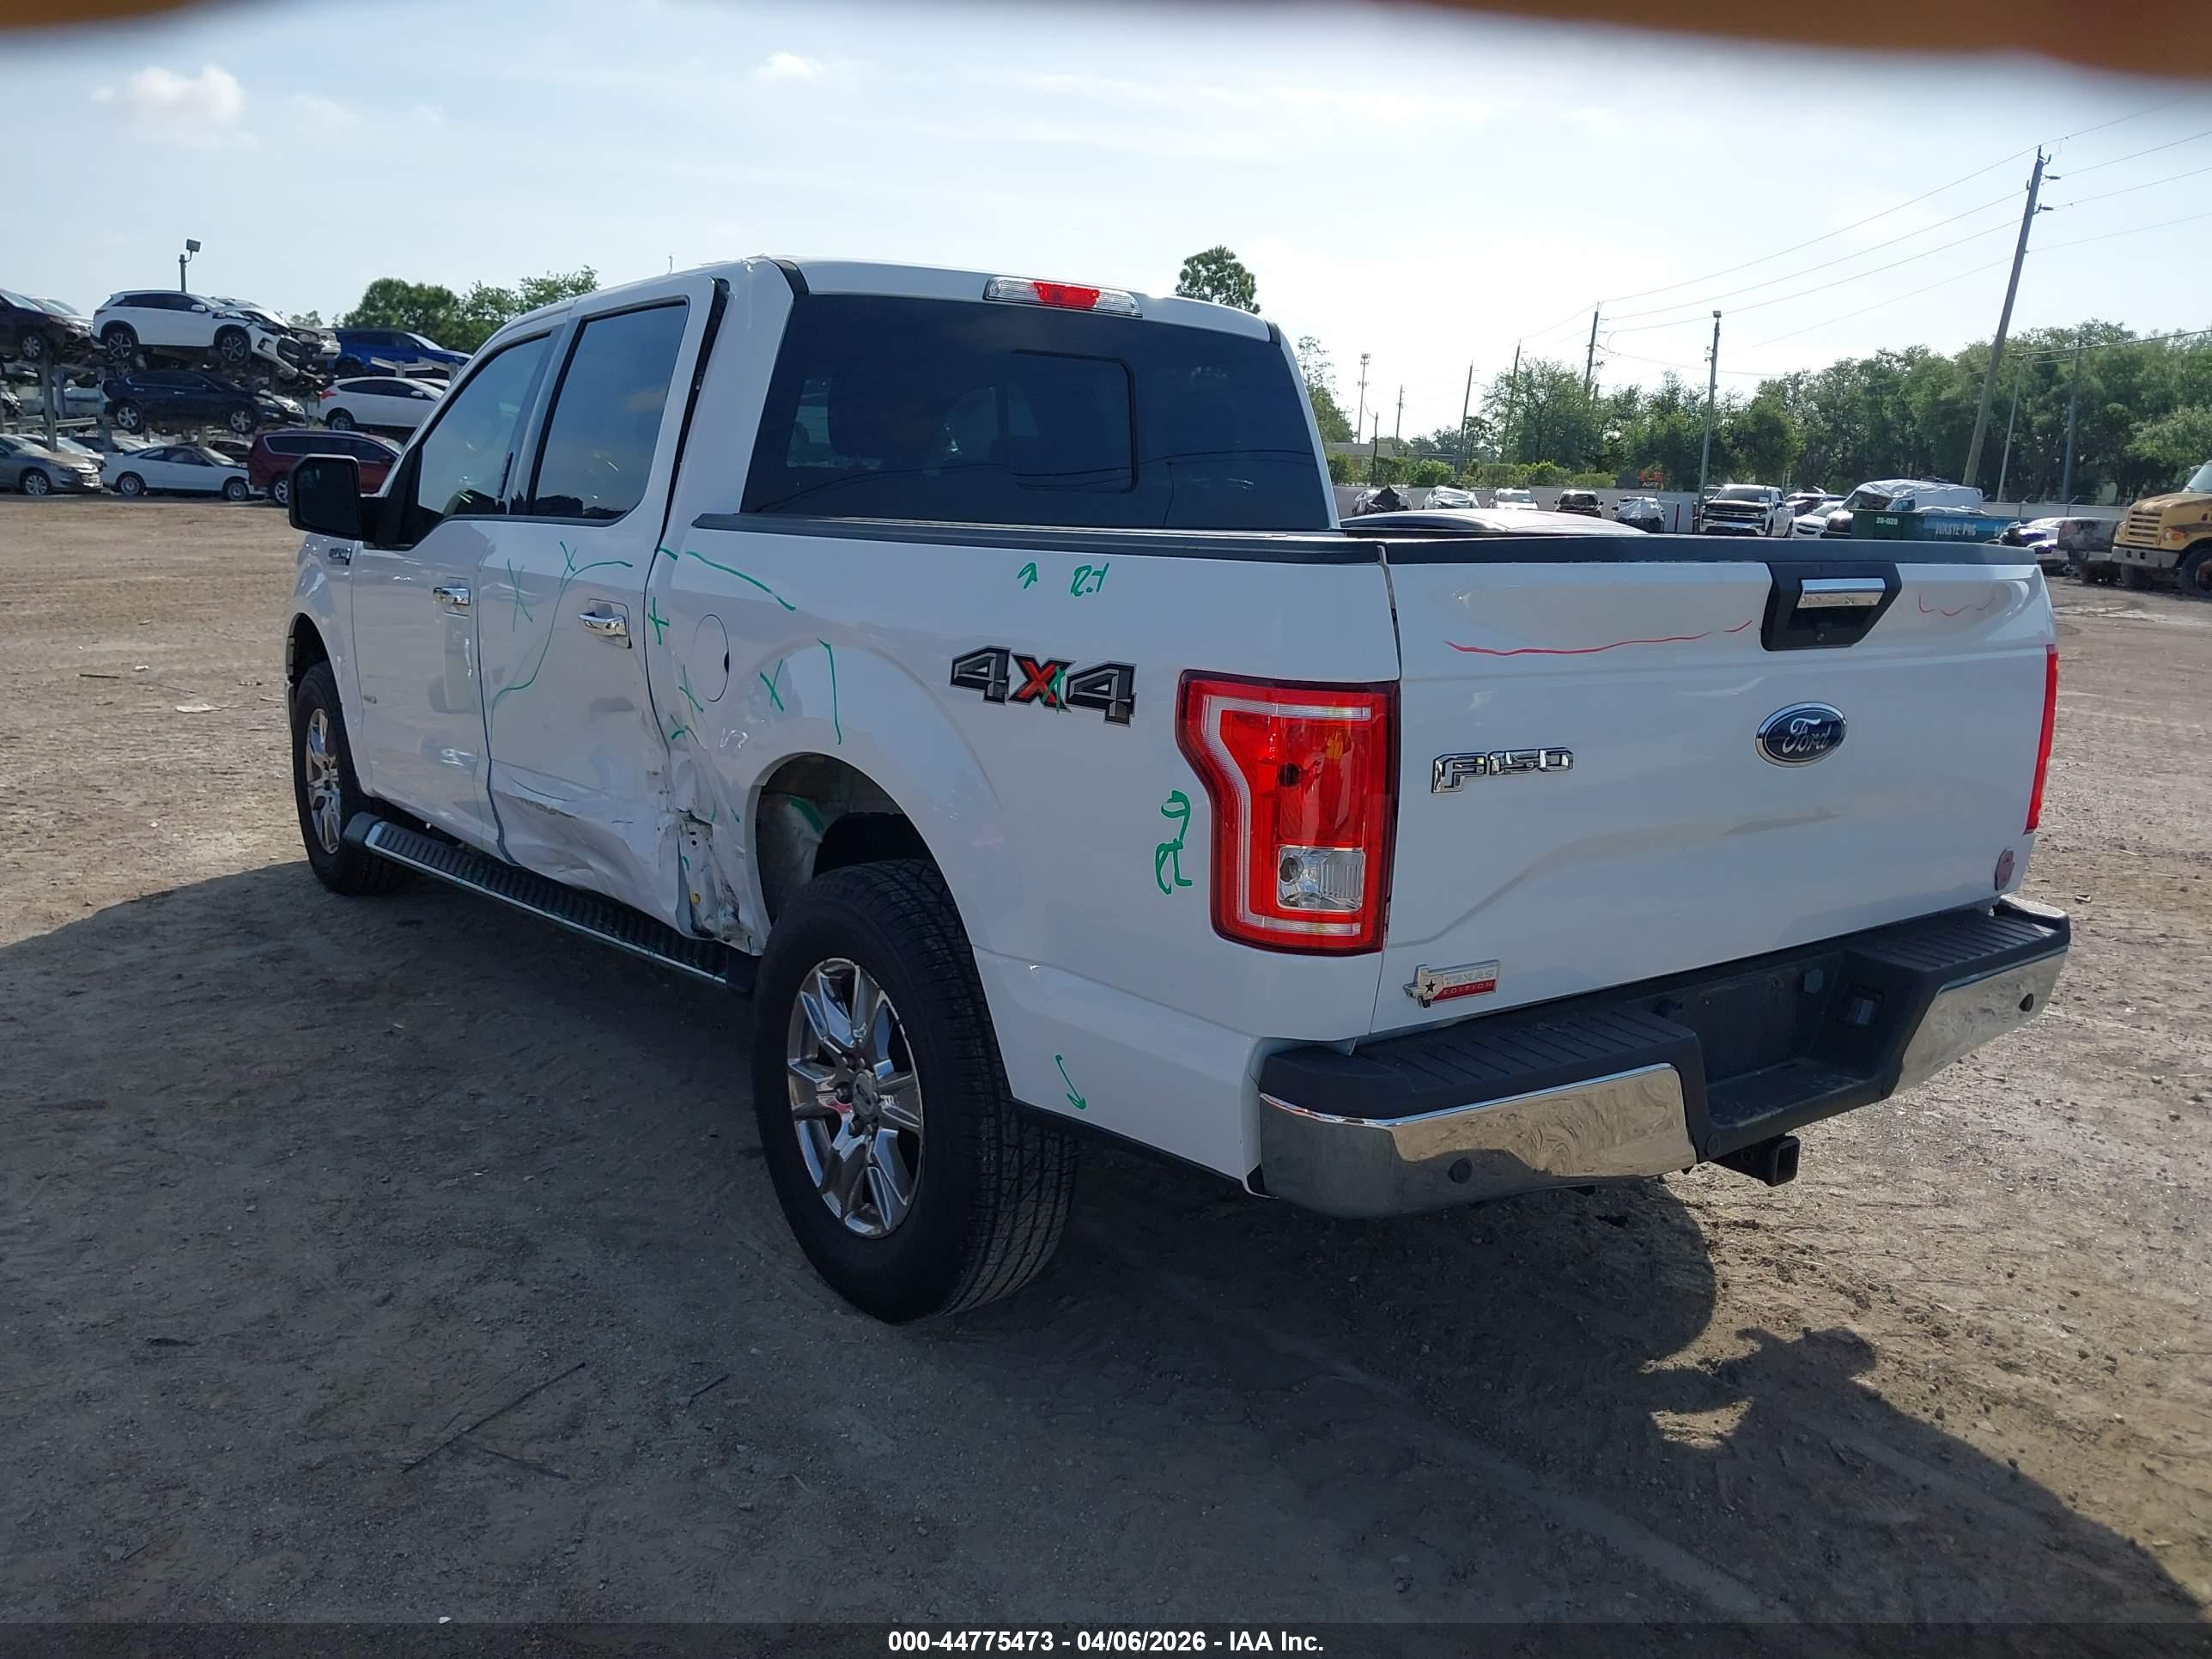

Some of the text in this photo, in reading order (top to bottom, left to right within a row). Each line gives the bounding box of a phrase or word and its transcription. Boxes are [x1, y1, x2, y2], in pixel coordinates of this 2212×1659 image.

[1936, 522, 1961, 536] WASTE
[1782, 718, 1832, 753] Ford
[1443, 969, 1495, 985] TEXAS
[1443, 981, 1493, 996] EDITION
